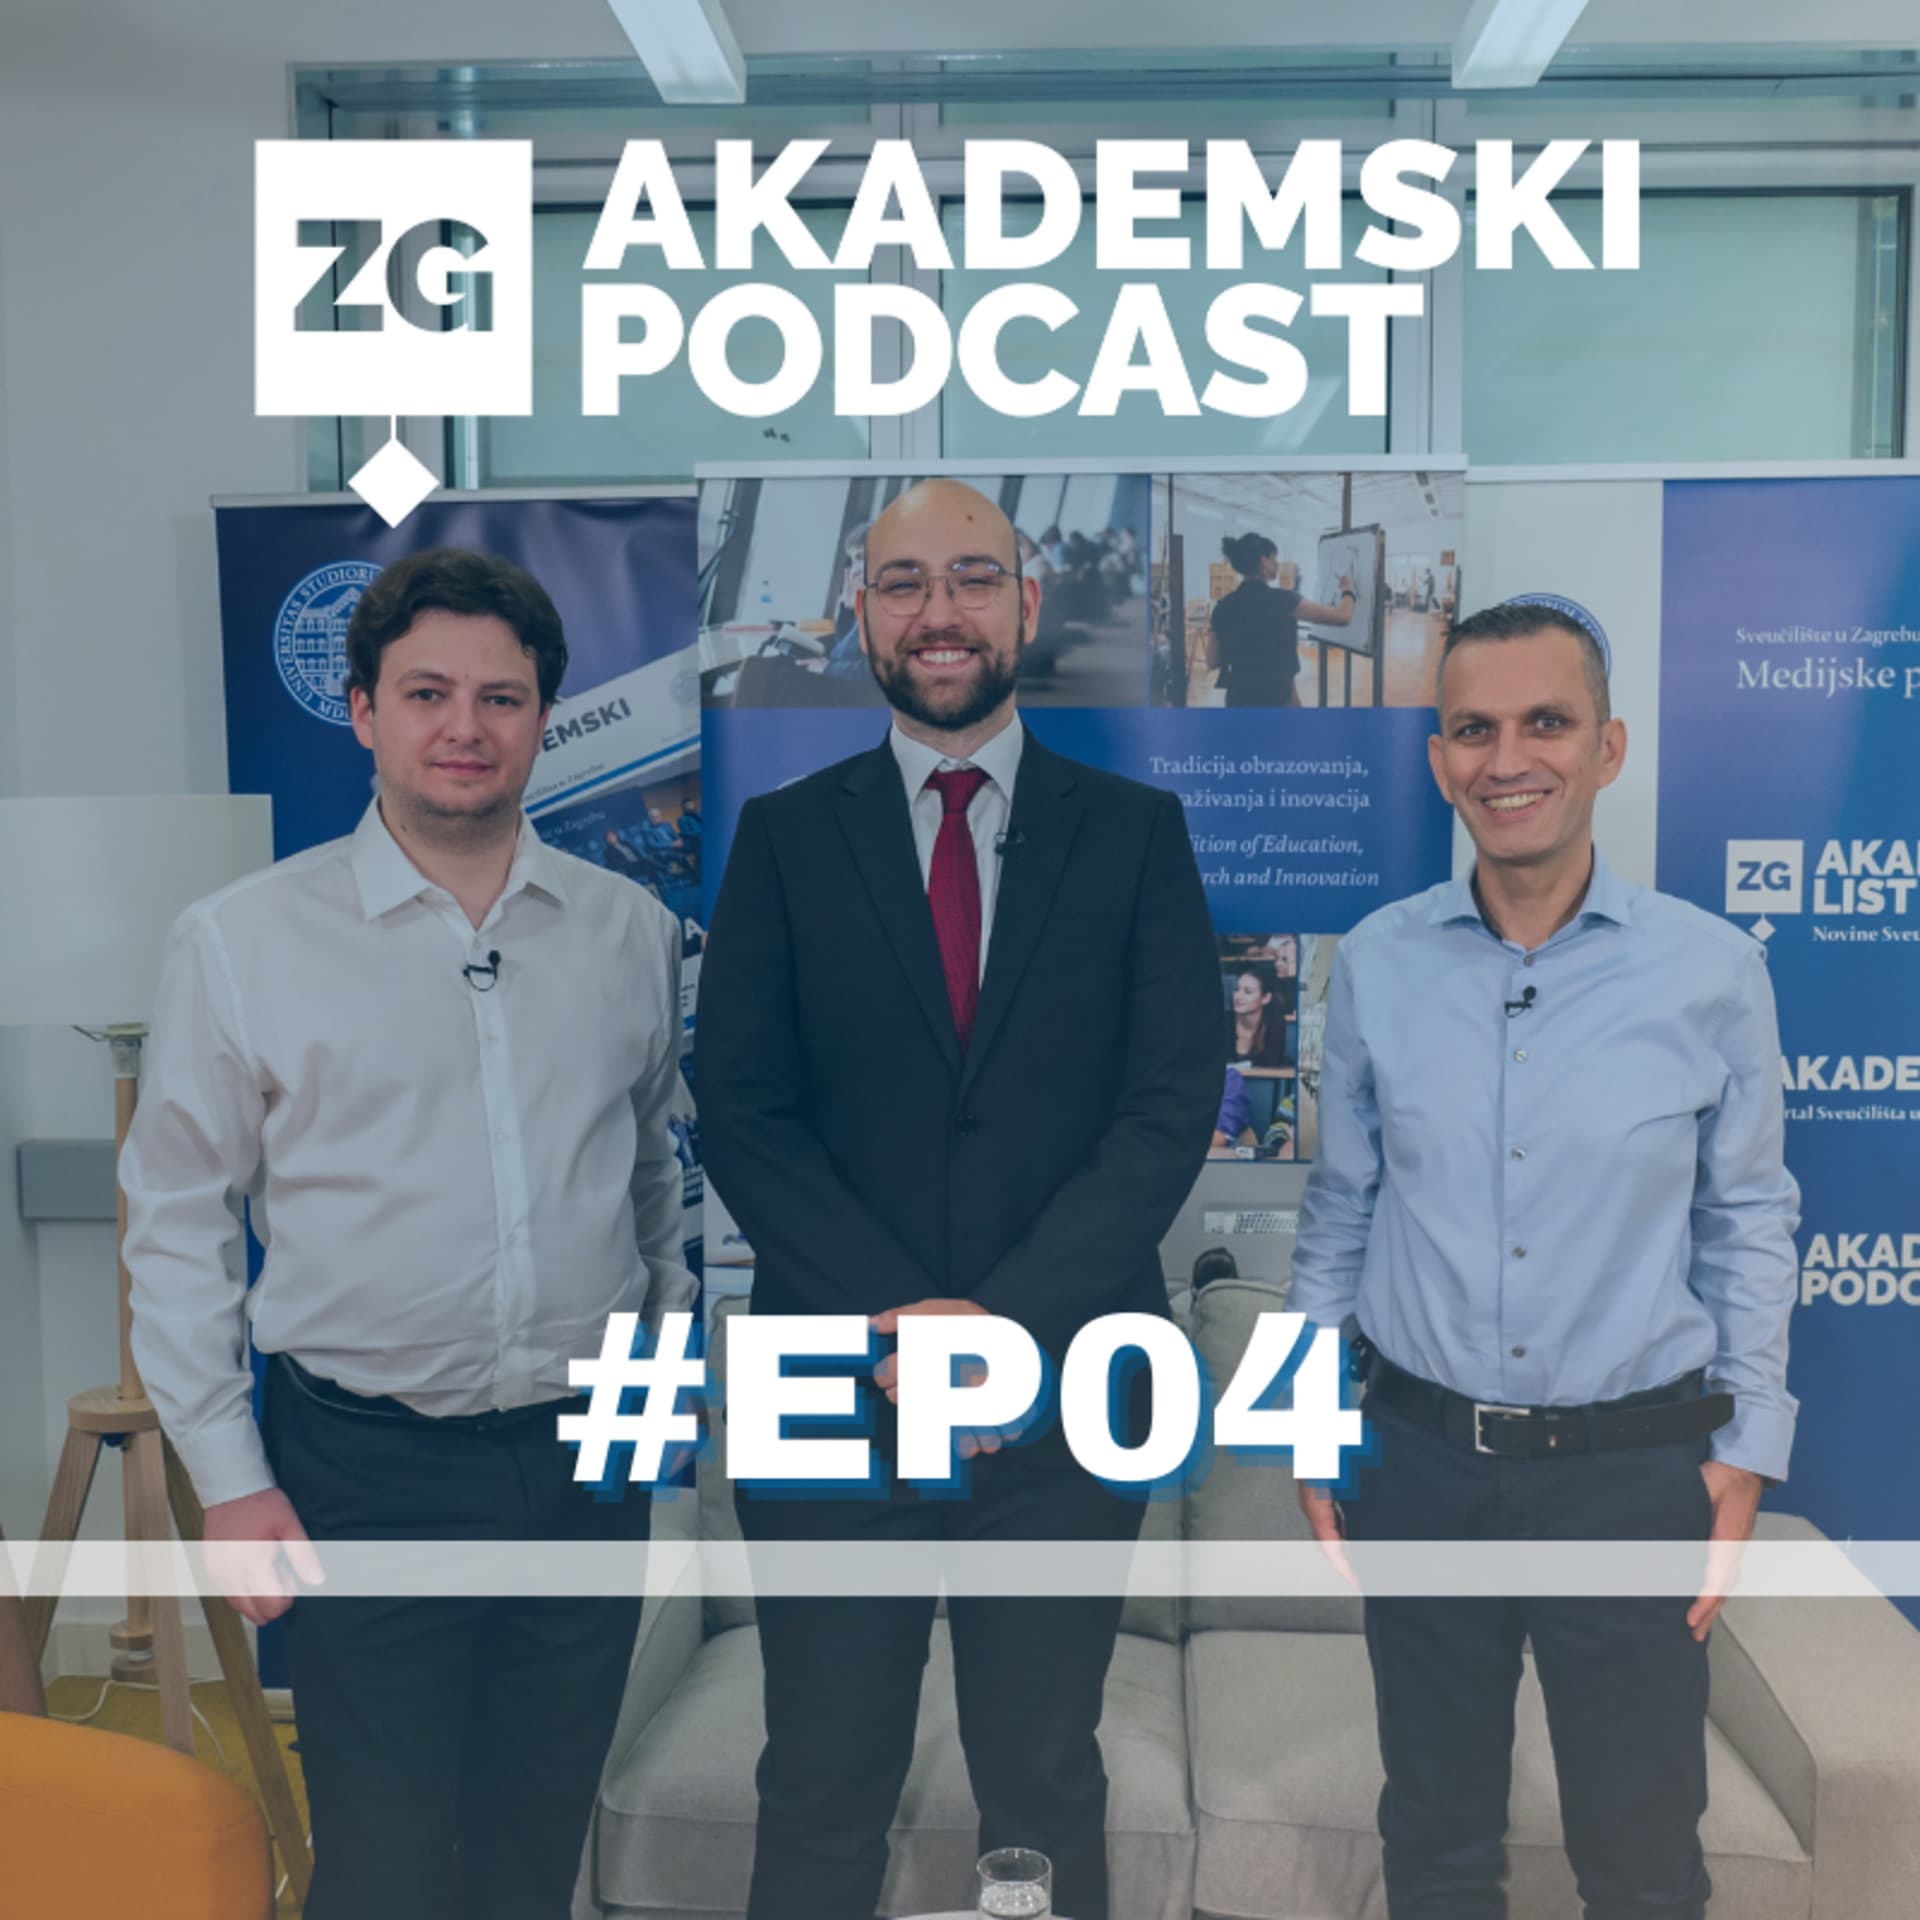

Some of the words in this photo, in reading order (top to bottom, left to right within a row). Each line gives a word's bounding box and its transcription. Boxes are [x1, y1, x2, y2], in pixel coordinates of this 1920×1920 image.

[1835, 631, 1847, 642] u
[1736, 656, 1896, 698] Medijske
[1150, 755, 1236, 778] Tradicija
[1240, 755, 1369, 778] obrazovanja,
[1269, 788, 1276, 807] i
[1280, 788, 1370, 812] inovacija
[1189, 834, 1236, 853] ition
[1240, 834, 1264, 857] of
[1263, 834, 1364, 856] Education,
[1815, 839, 1920, 876] AKA
[1234, 867, 1271, 886] and
[1275, 867, 1379, 887] Innovation
[1737, 860, 1791, 892] ZG
[1813, 878, 1917, 915] LIST
[1813, 925, 1878, 942] Novine
